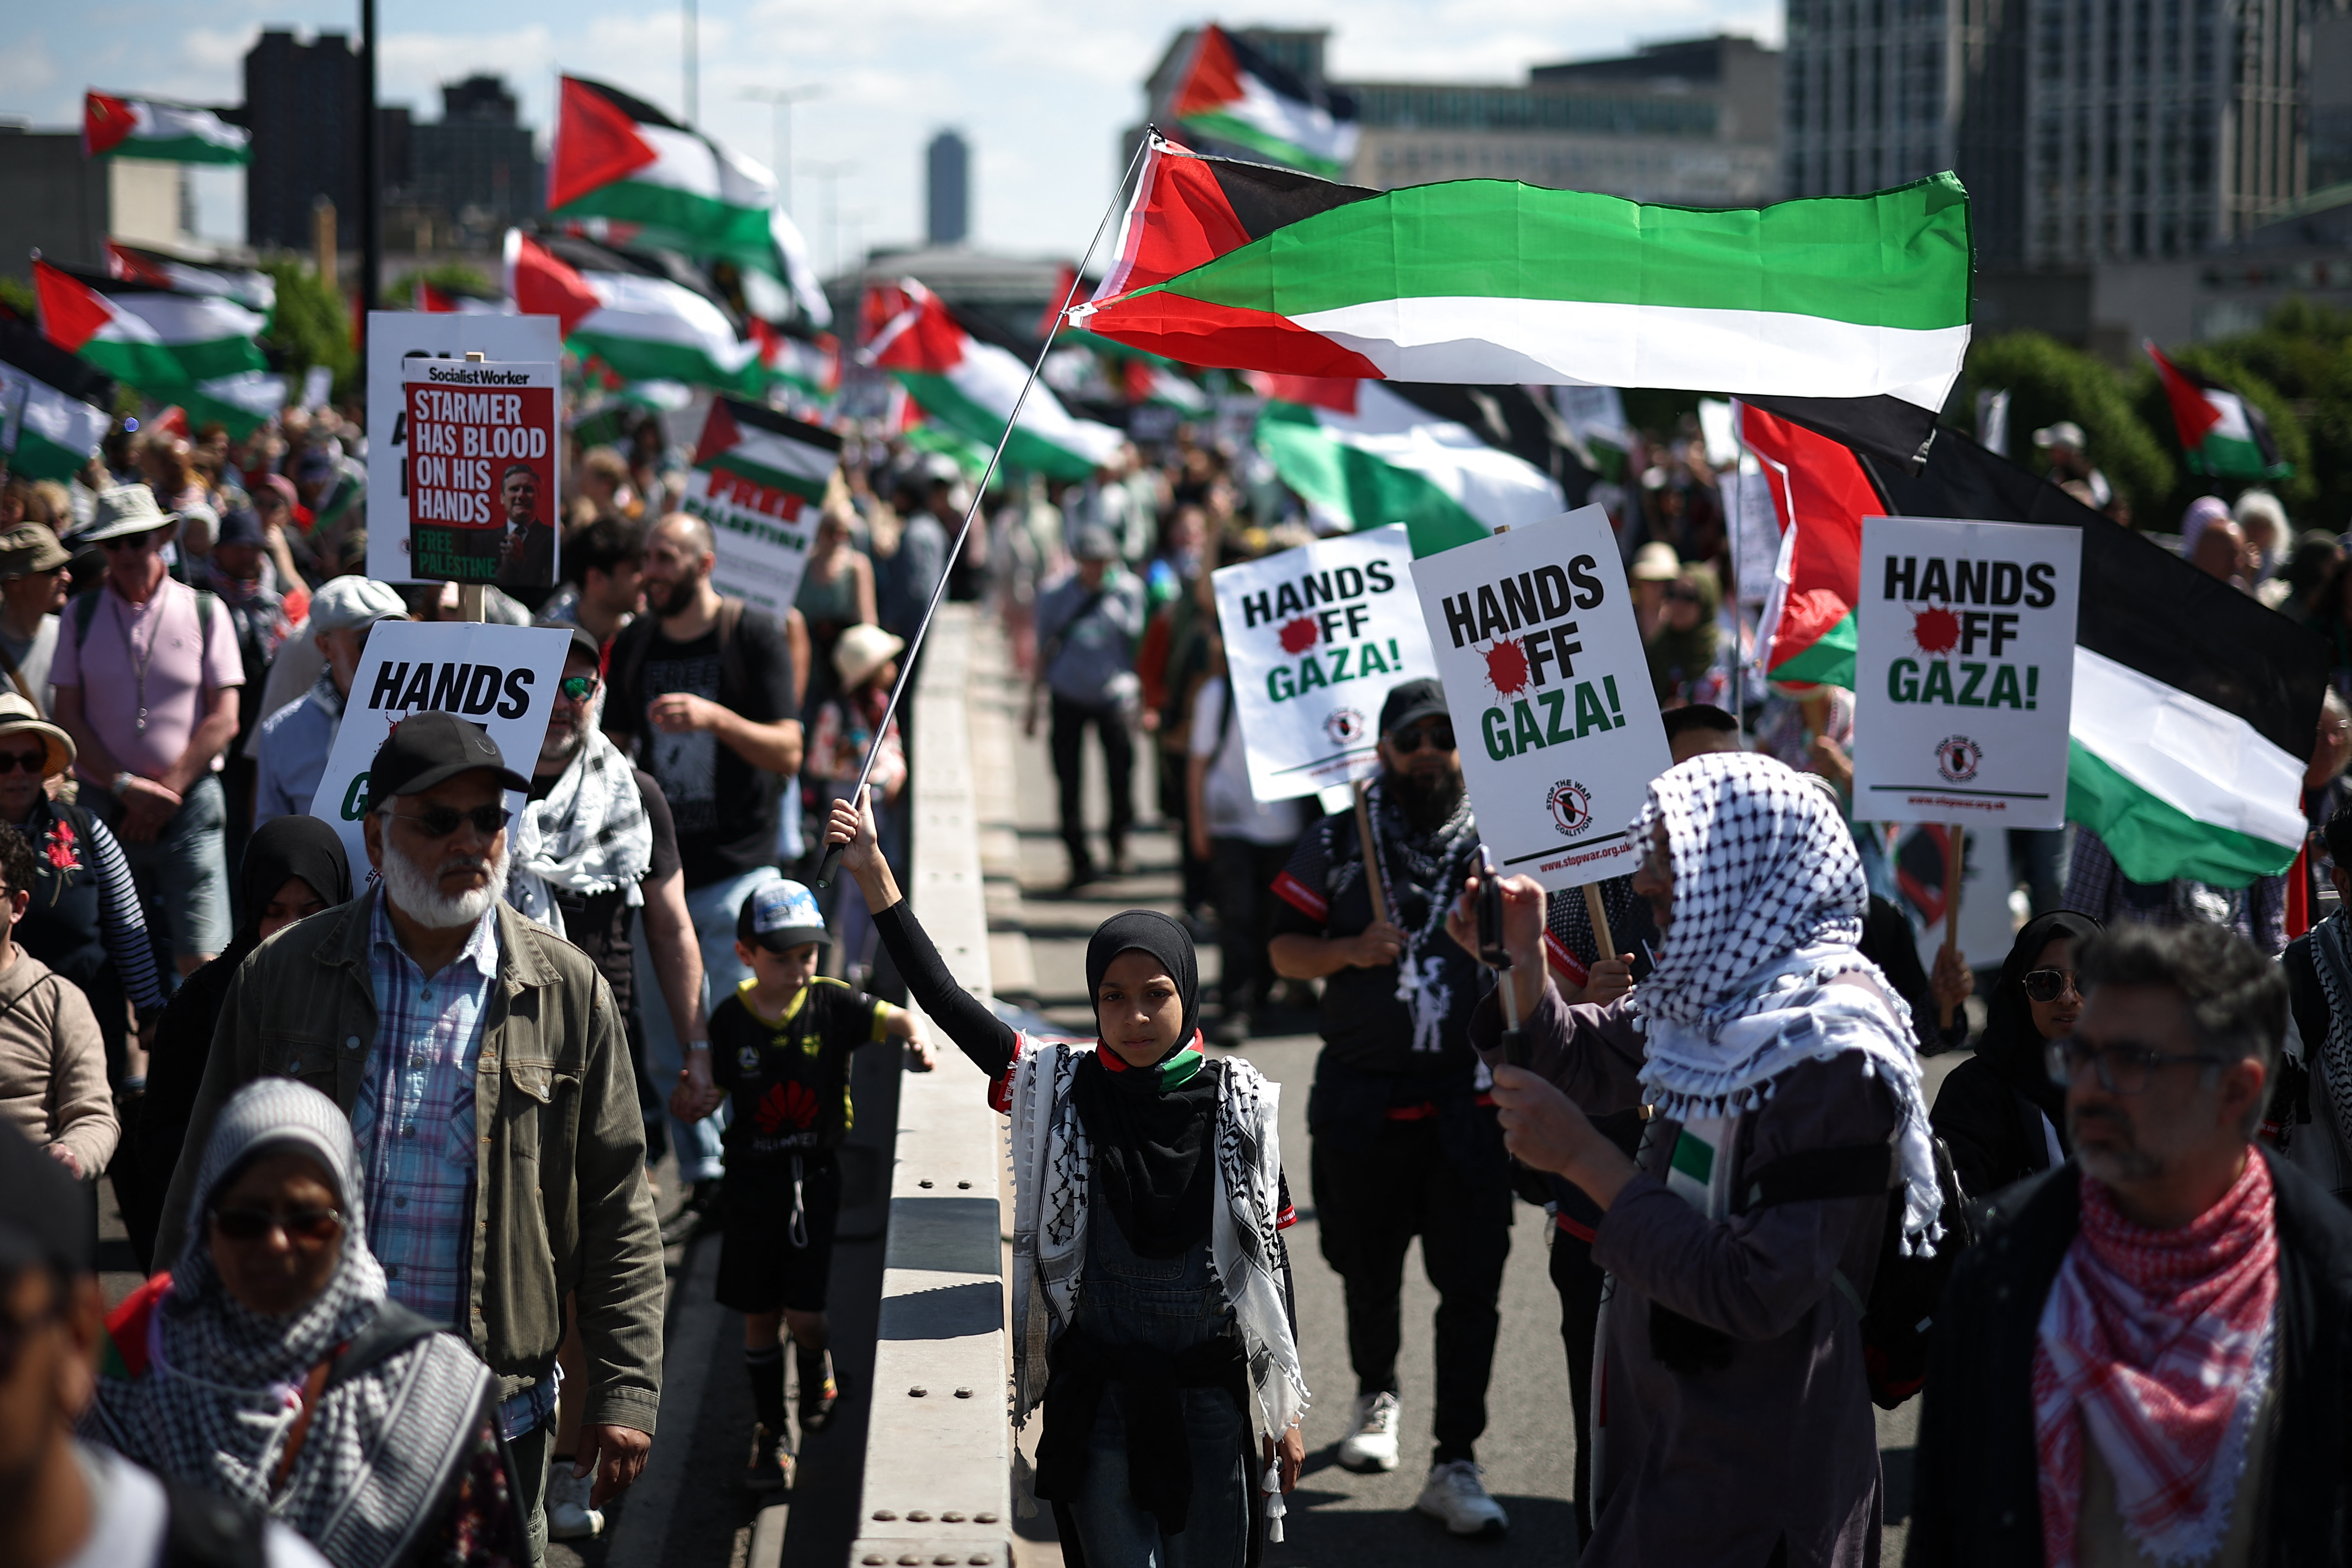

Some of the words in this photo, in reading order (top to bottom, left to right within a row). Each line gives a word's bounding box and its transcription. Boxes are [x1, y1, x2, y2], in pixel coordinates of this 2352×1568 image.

[429, 366, 479, 384] Socialist
[480, 370, 530, 385] Worker
[415, 390, 522, 425] STARMER
[416, 423, 457, 456] HAS
[463, 427, 547, 459] BLOOD
[417, 455, 447, 487] ON
[453, 459, 492, 491] HIS
[418, 488, 491, 524] HANDS
[707, 467, 804, 523] FREE
[418, 529, 453, 554] FREE
[418, 551, 497, 579] PALESTINE
[1884, 556, 2056, 609] HANDS
[1242, 560, 1395, 628] HANDS
[1442, 554, 1604, 649] HANDS
[1266, 637, 1404, 704] GAZA!
[1888, 658, 2040, 710] GAZA!
[368, 661, 535, 719] HANDS
[1481, 674, 1626, 761] GAZA!
[1546, 787, 1555, 810] STOP
[1555, 779, 1572, 788] THE
[1574, 781, 1592, 800] WAR
[1555, 815, 1593, 836] COALITION
[365, 867, 378, 882] STO
[1539, 841, 1631, 872] www.stopwar.org.uk
